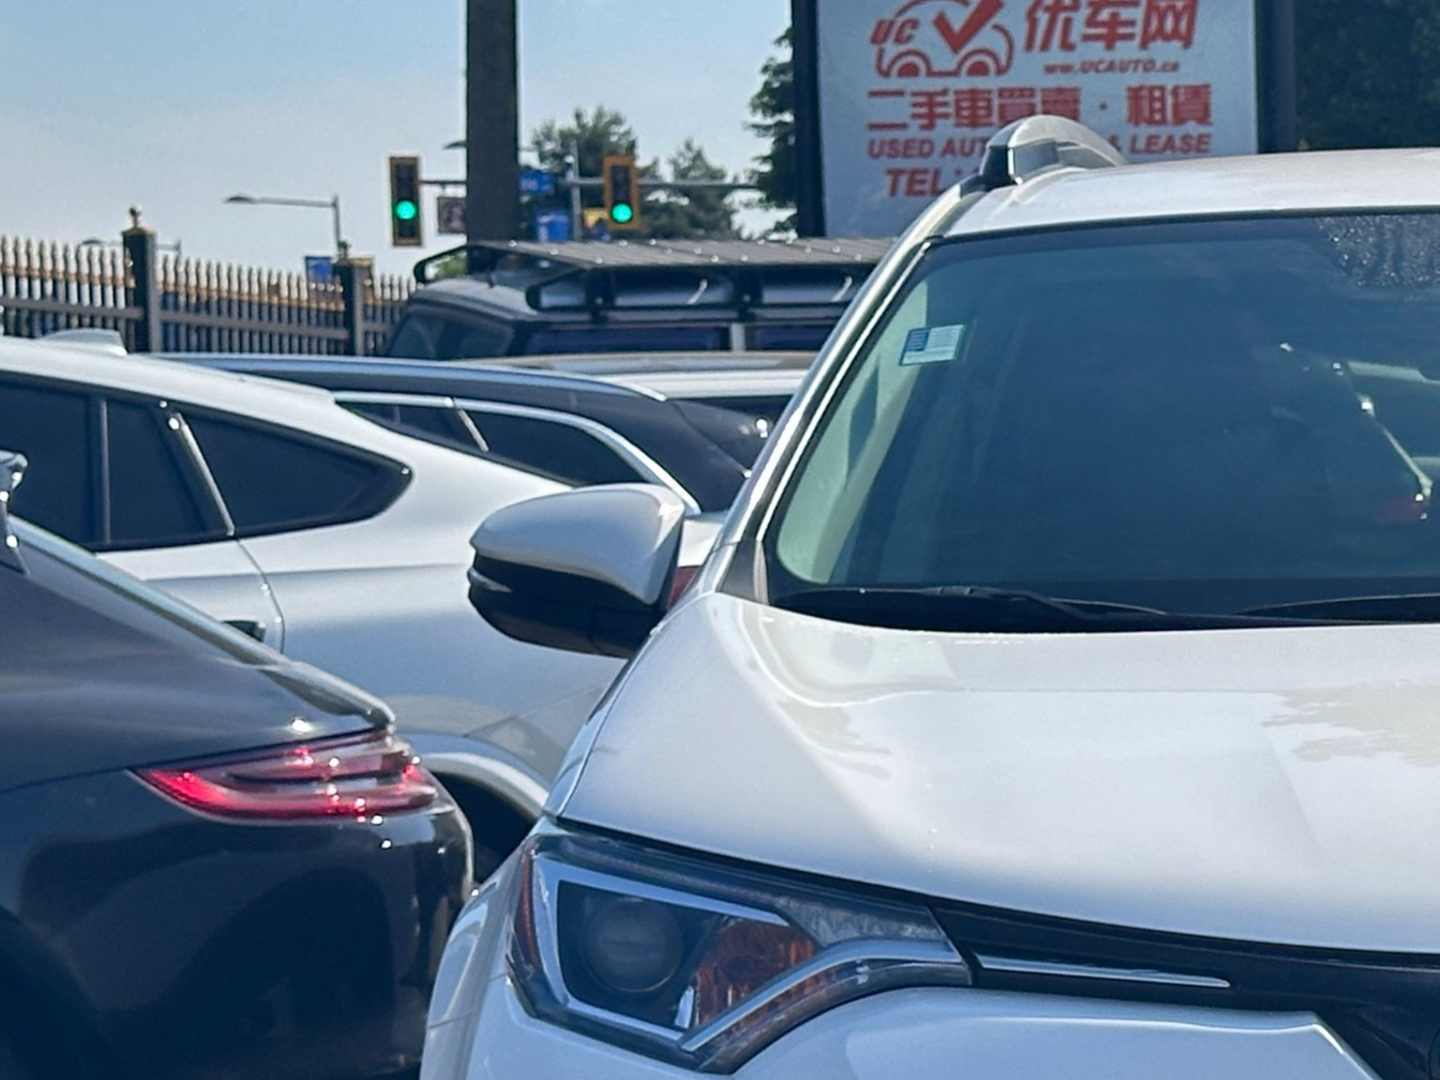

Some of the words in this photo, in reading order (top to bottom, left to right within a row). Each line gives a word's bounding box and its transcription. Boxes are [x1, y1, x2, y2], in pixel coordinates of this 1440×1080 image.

[870, 18, 920, 45] UC
[1024, 0, 1198, 53] 优车网
[868, 138, 935, 160] USED
[940, 137, 989, 158] AUT
[1131, 133, 1211, 153] LEASE
